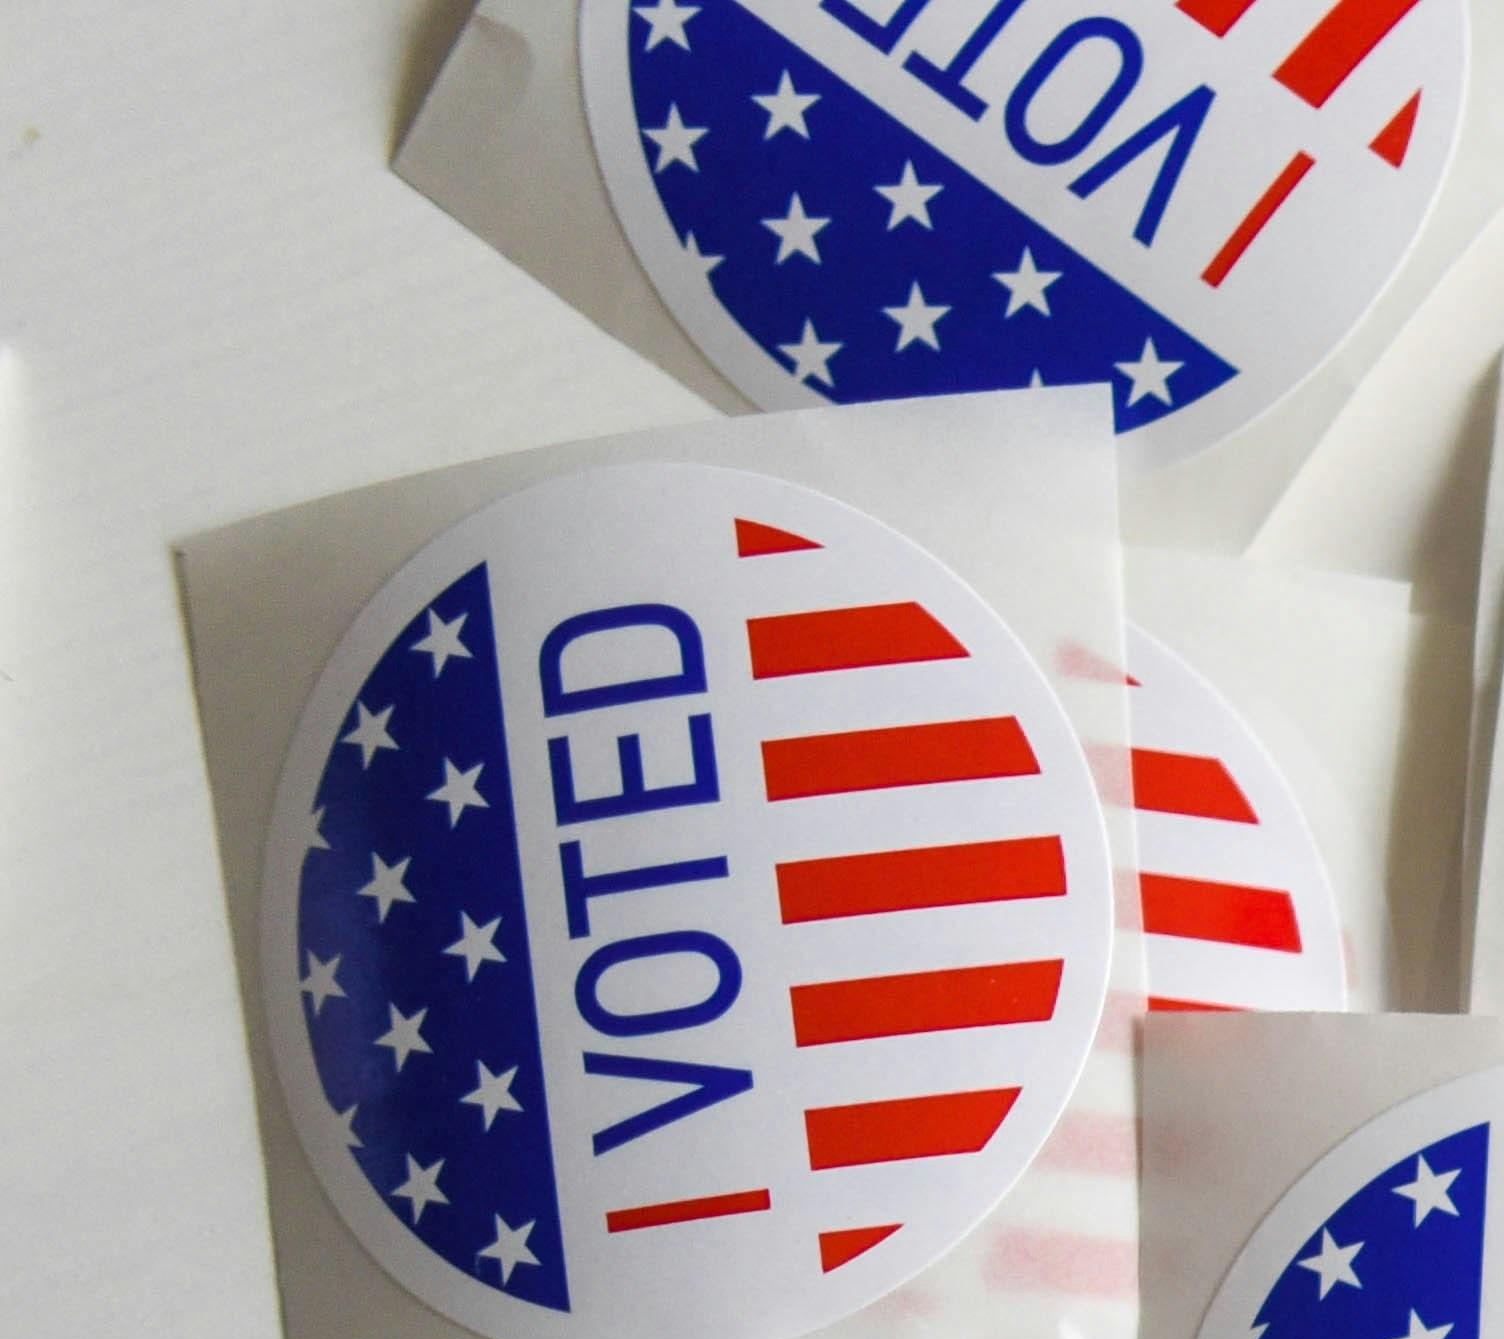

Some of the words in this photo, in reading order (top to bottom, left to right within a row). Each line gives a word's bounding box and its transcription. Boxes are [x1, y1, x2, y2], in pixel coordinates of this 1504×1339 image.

[821, 0, 1216, 246] VOT
[1202, 152, 1315, 287] I
[541, 605, 755, 1153] VOTED
[608, 1189, 771, 1232] I
